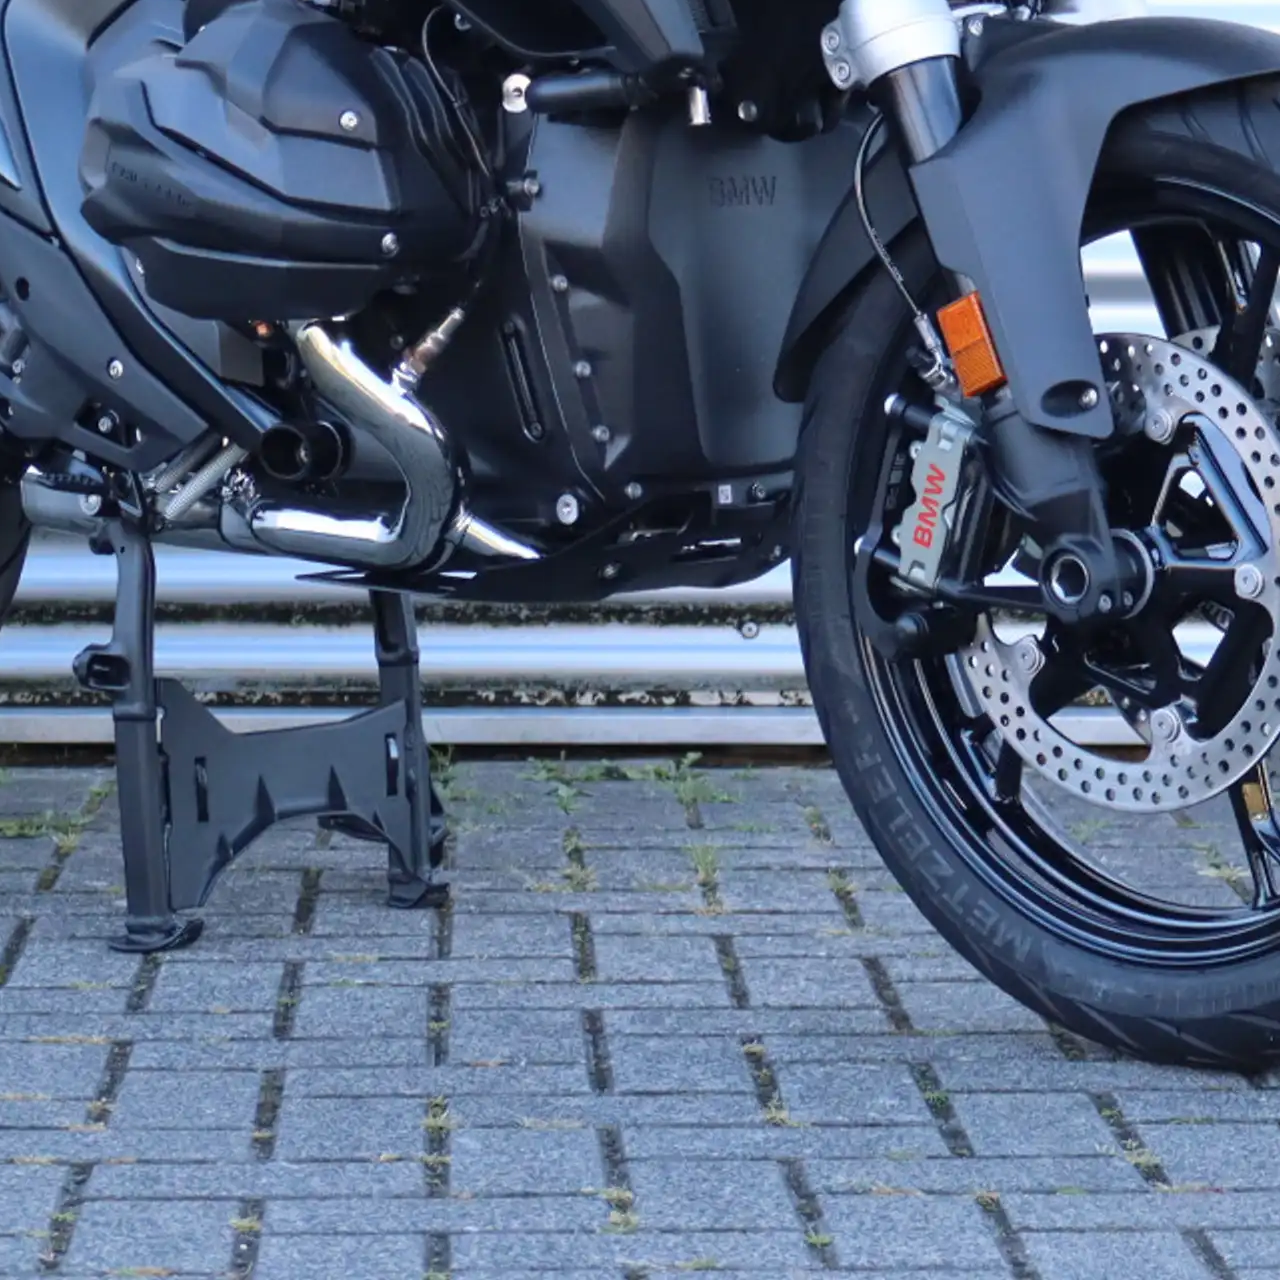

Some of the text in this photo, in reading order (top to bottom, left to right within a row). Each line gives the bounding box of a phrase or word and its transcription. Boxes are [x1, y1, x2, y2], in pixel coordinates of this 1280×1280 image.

[707, 175, 777, 208] BMW
[912, 463, 947, 550] BMW
[852, 732, 1035, 962] METZELER
